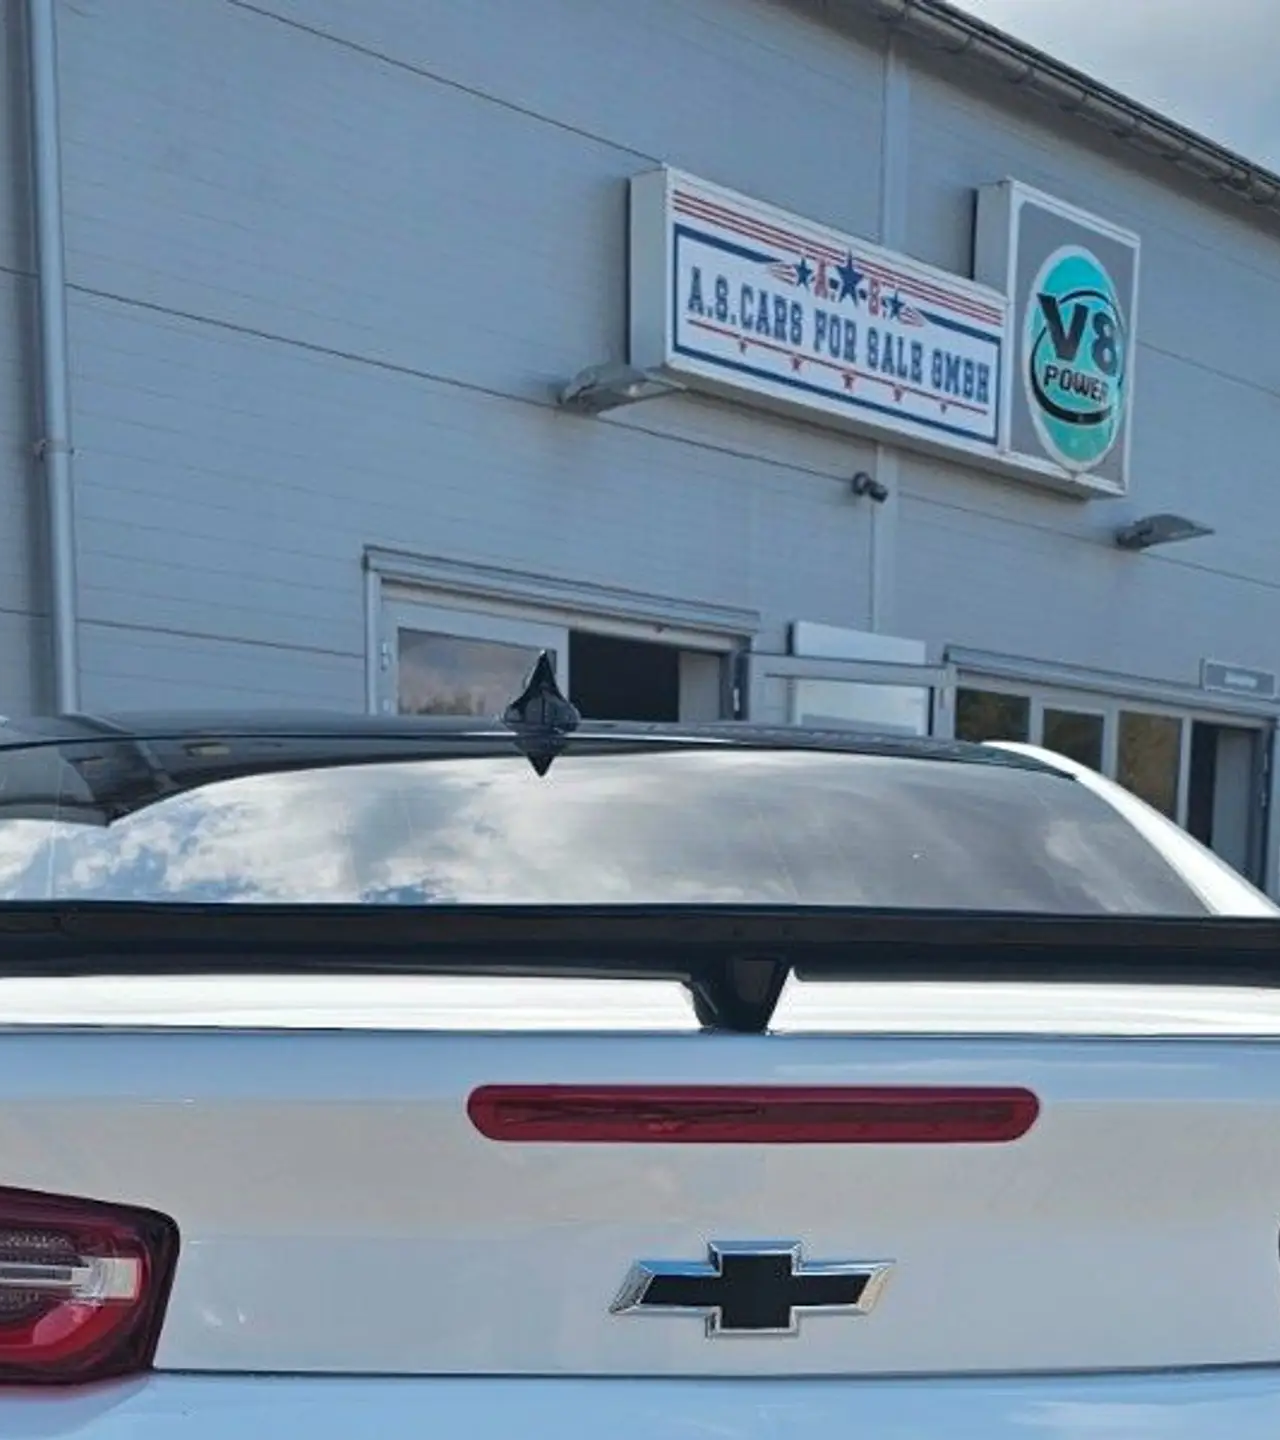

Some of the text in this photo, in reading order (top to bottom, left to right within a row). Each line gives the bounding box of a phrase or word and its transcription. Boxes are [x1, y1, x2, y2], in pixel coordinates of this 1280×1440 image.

[814, 309, 858, 364] FOR
[867, 326, 922, 385] SALE
[1037, 292, 1118, 378] V8
[1043, 364, 1110, 405] POWER
